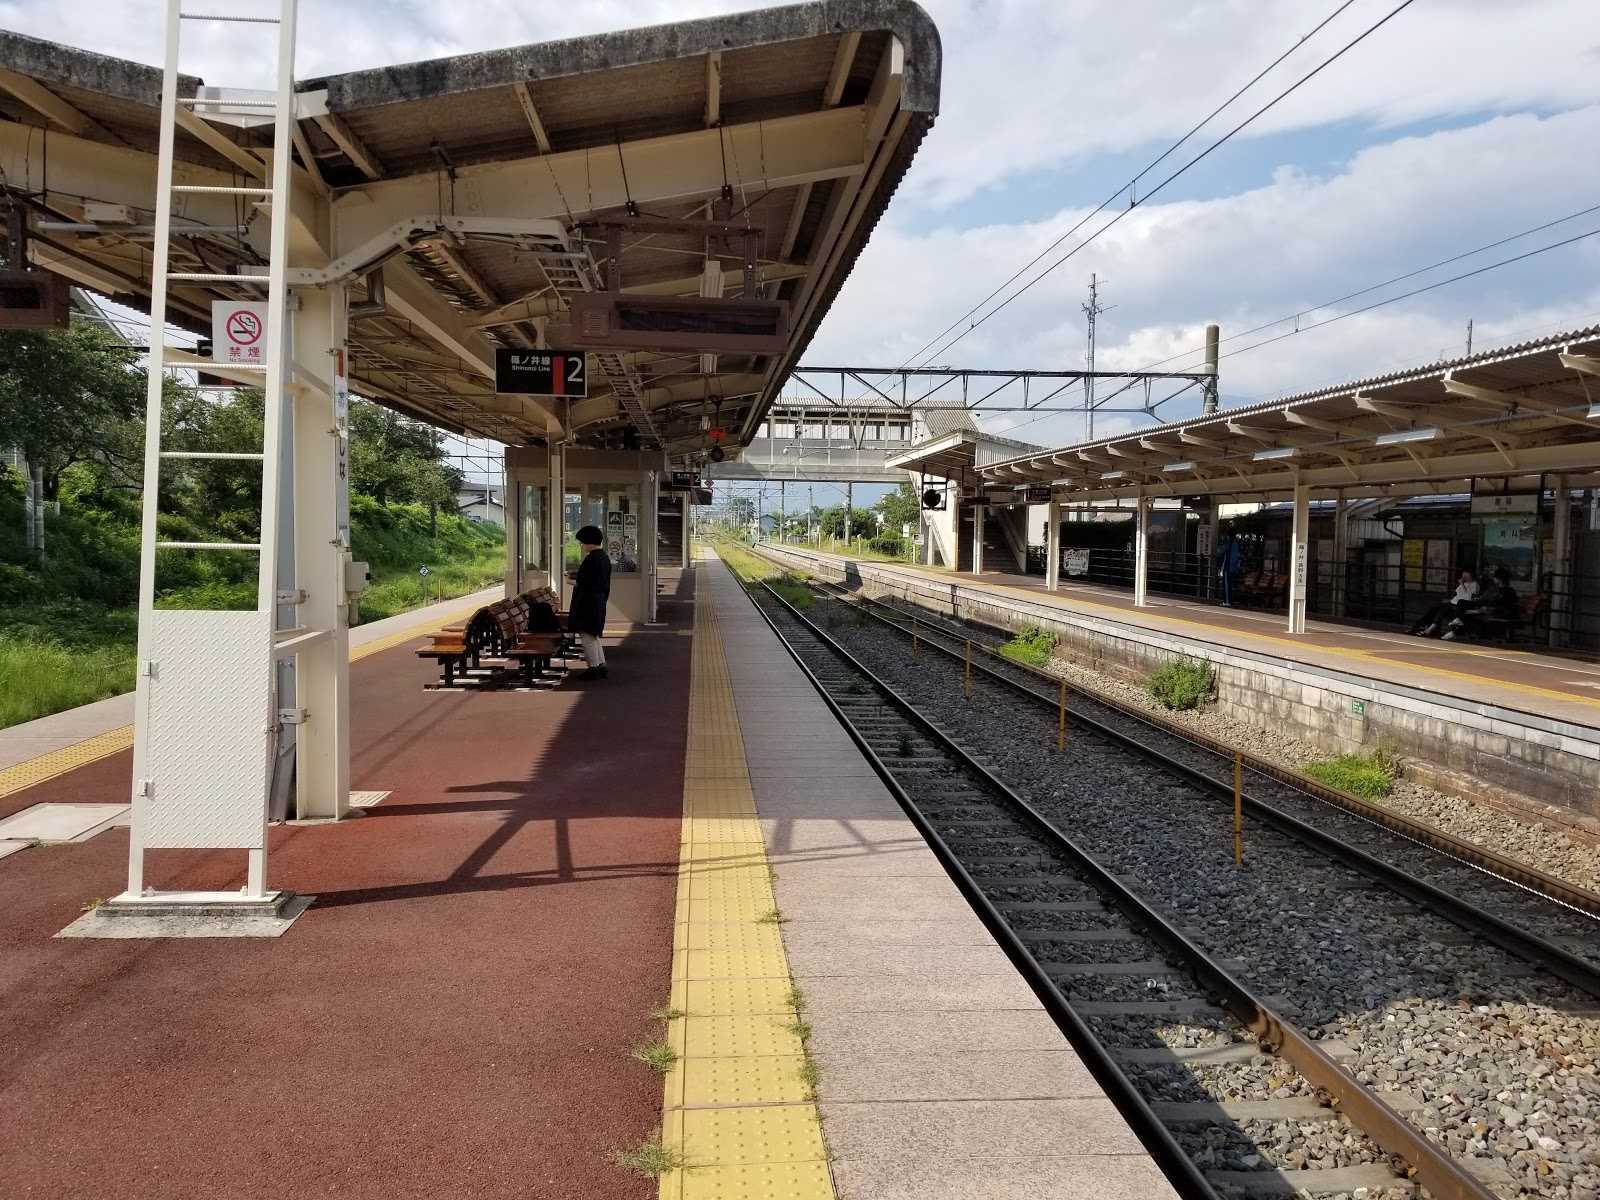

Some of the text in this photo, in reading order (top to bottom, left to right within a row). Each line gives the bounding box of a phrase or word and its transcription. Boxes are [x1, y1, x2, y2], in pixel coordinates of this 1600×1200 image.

[228, 346, 261, 357] 禁煙
[510, 355, 551, 366] 篠ノ井線
[567, 356, 584, 382] 2
[694, 473, 701, 483] 2
